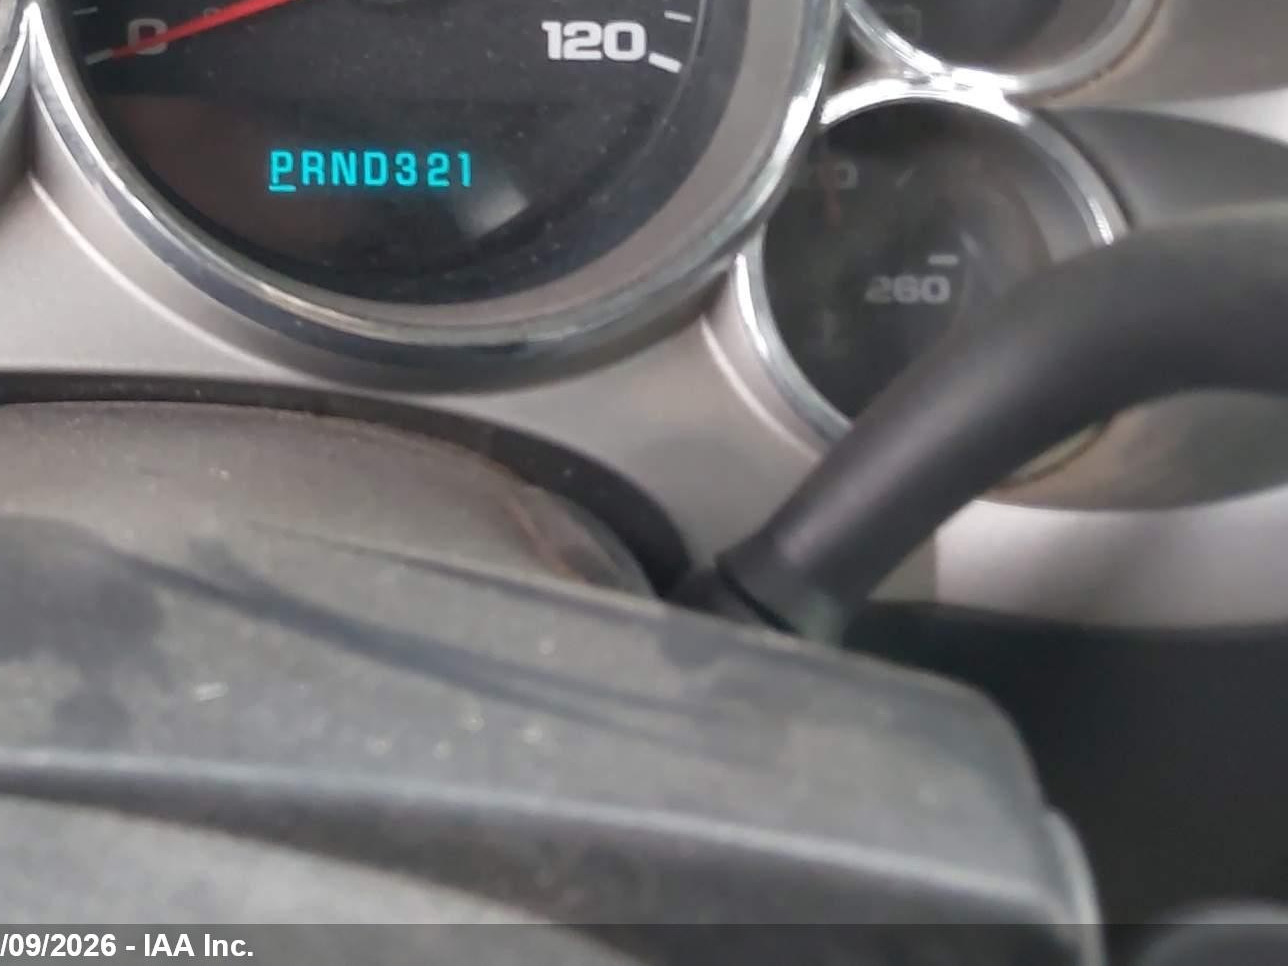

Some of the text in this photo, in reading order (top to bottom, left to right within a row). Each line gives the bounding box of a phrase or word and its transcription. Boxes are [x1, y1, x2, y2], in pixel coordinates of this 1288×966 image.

[542, 22, 645, 60] 120
[269, 151, 470, 191] PRND321
[864, 275, 951, 304] 260
